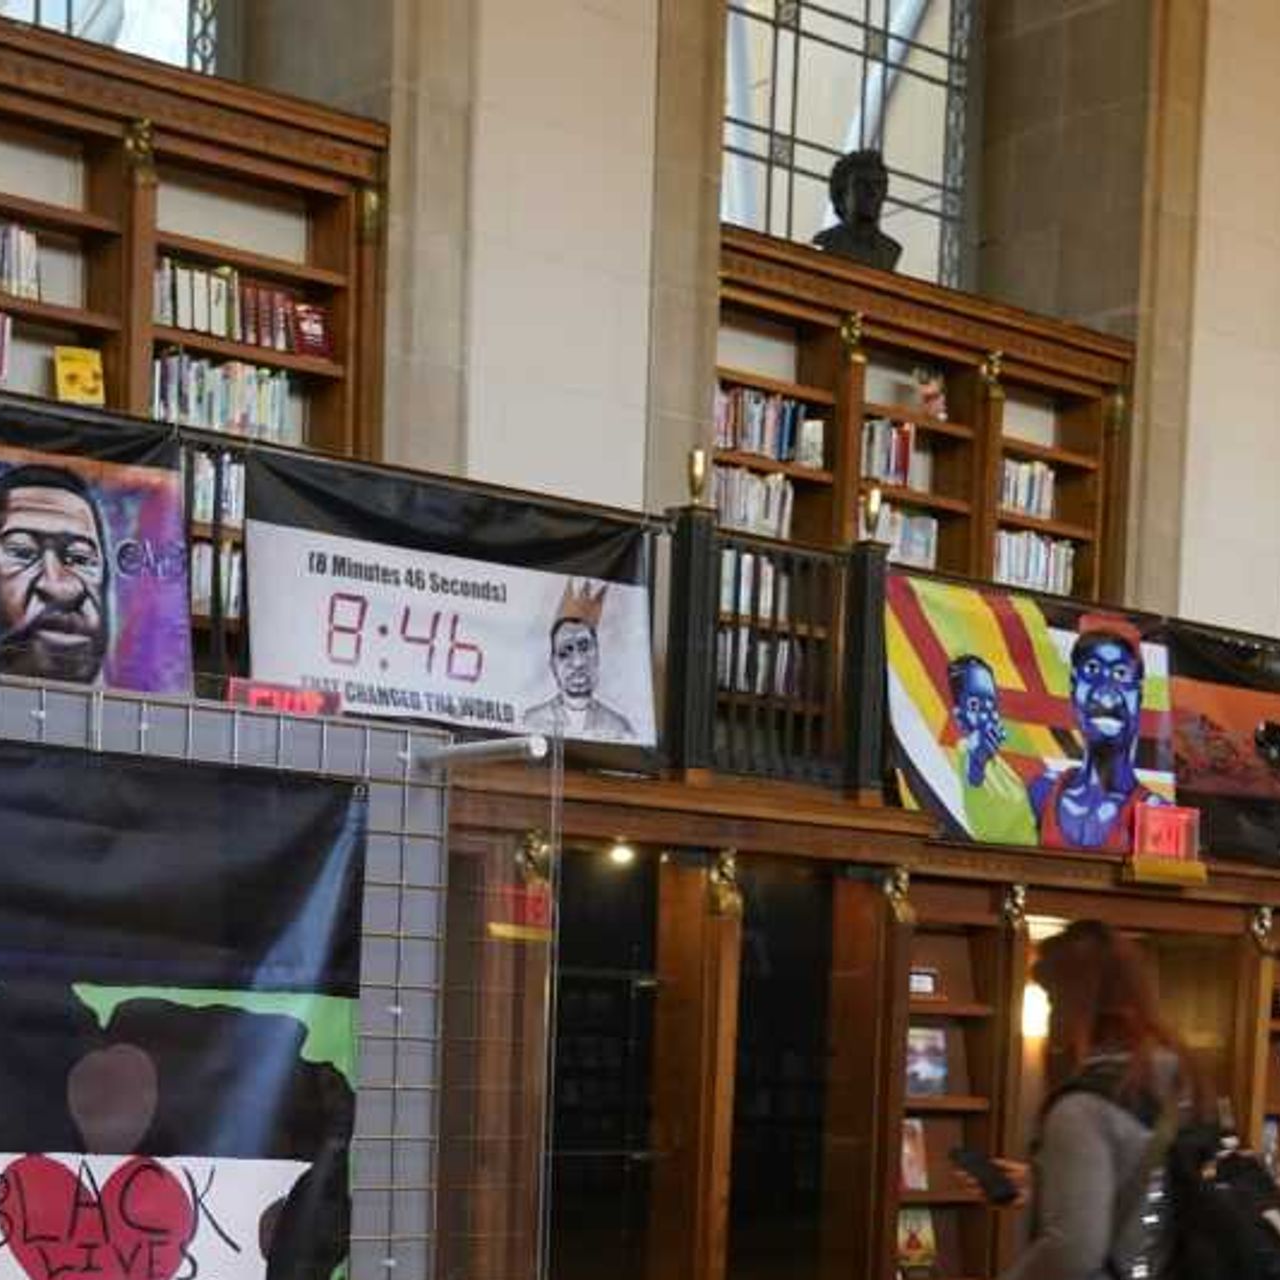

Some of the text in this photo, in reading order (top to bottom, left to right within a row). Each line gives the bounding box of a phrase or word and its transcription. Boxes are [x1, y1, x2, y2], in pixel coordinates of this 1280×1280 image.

[331, 554, 400, 586] Minutes
[404, 566, 426, 591] 46
[327, 592, 483, 684] 8:46
[344, 681, 420, 711] CHANGED
[459, 696, 515, 724] WORLD
